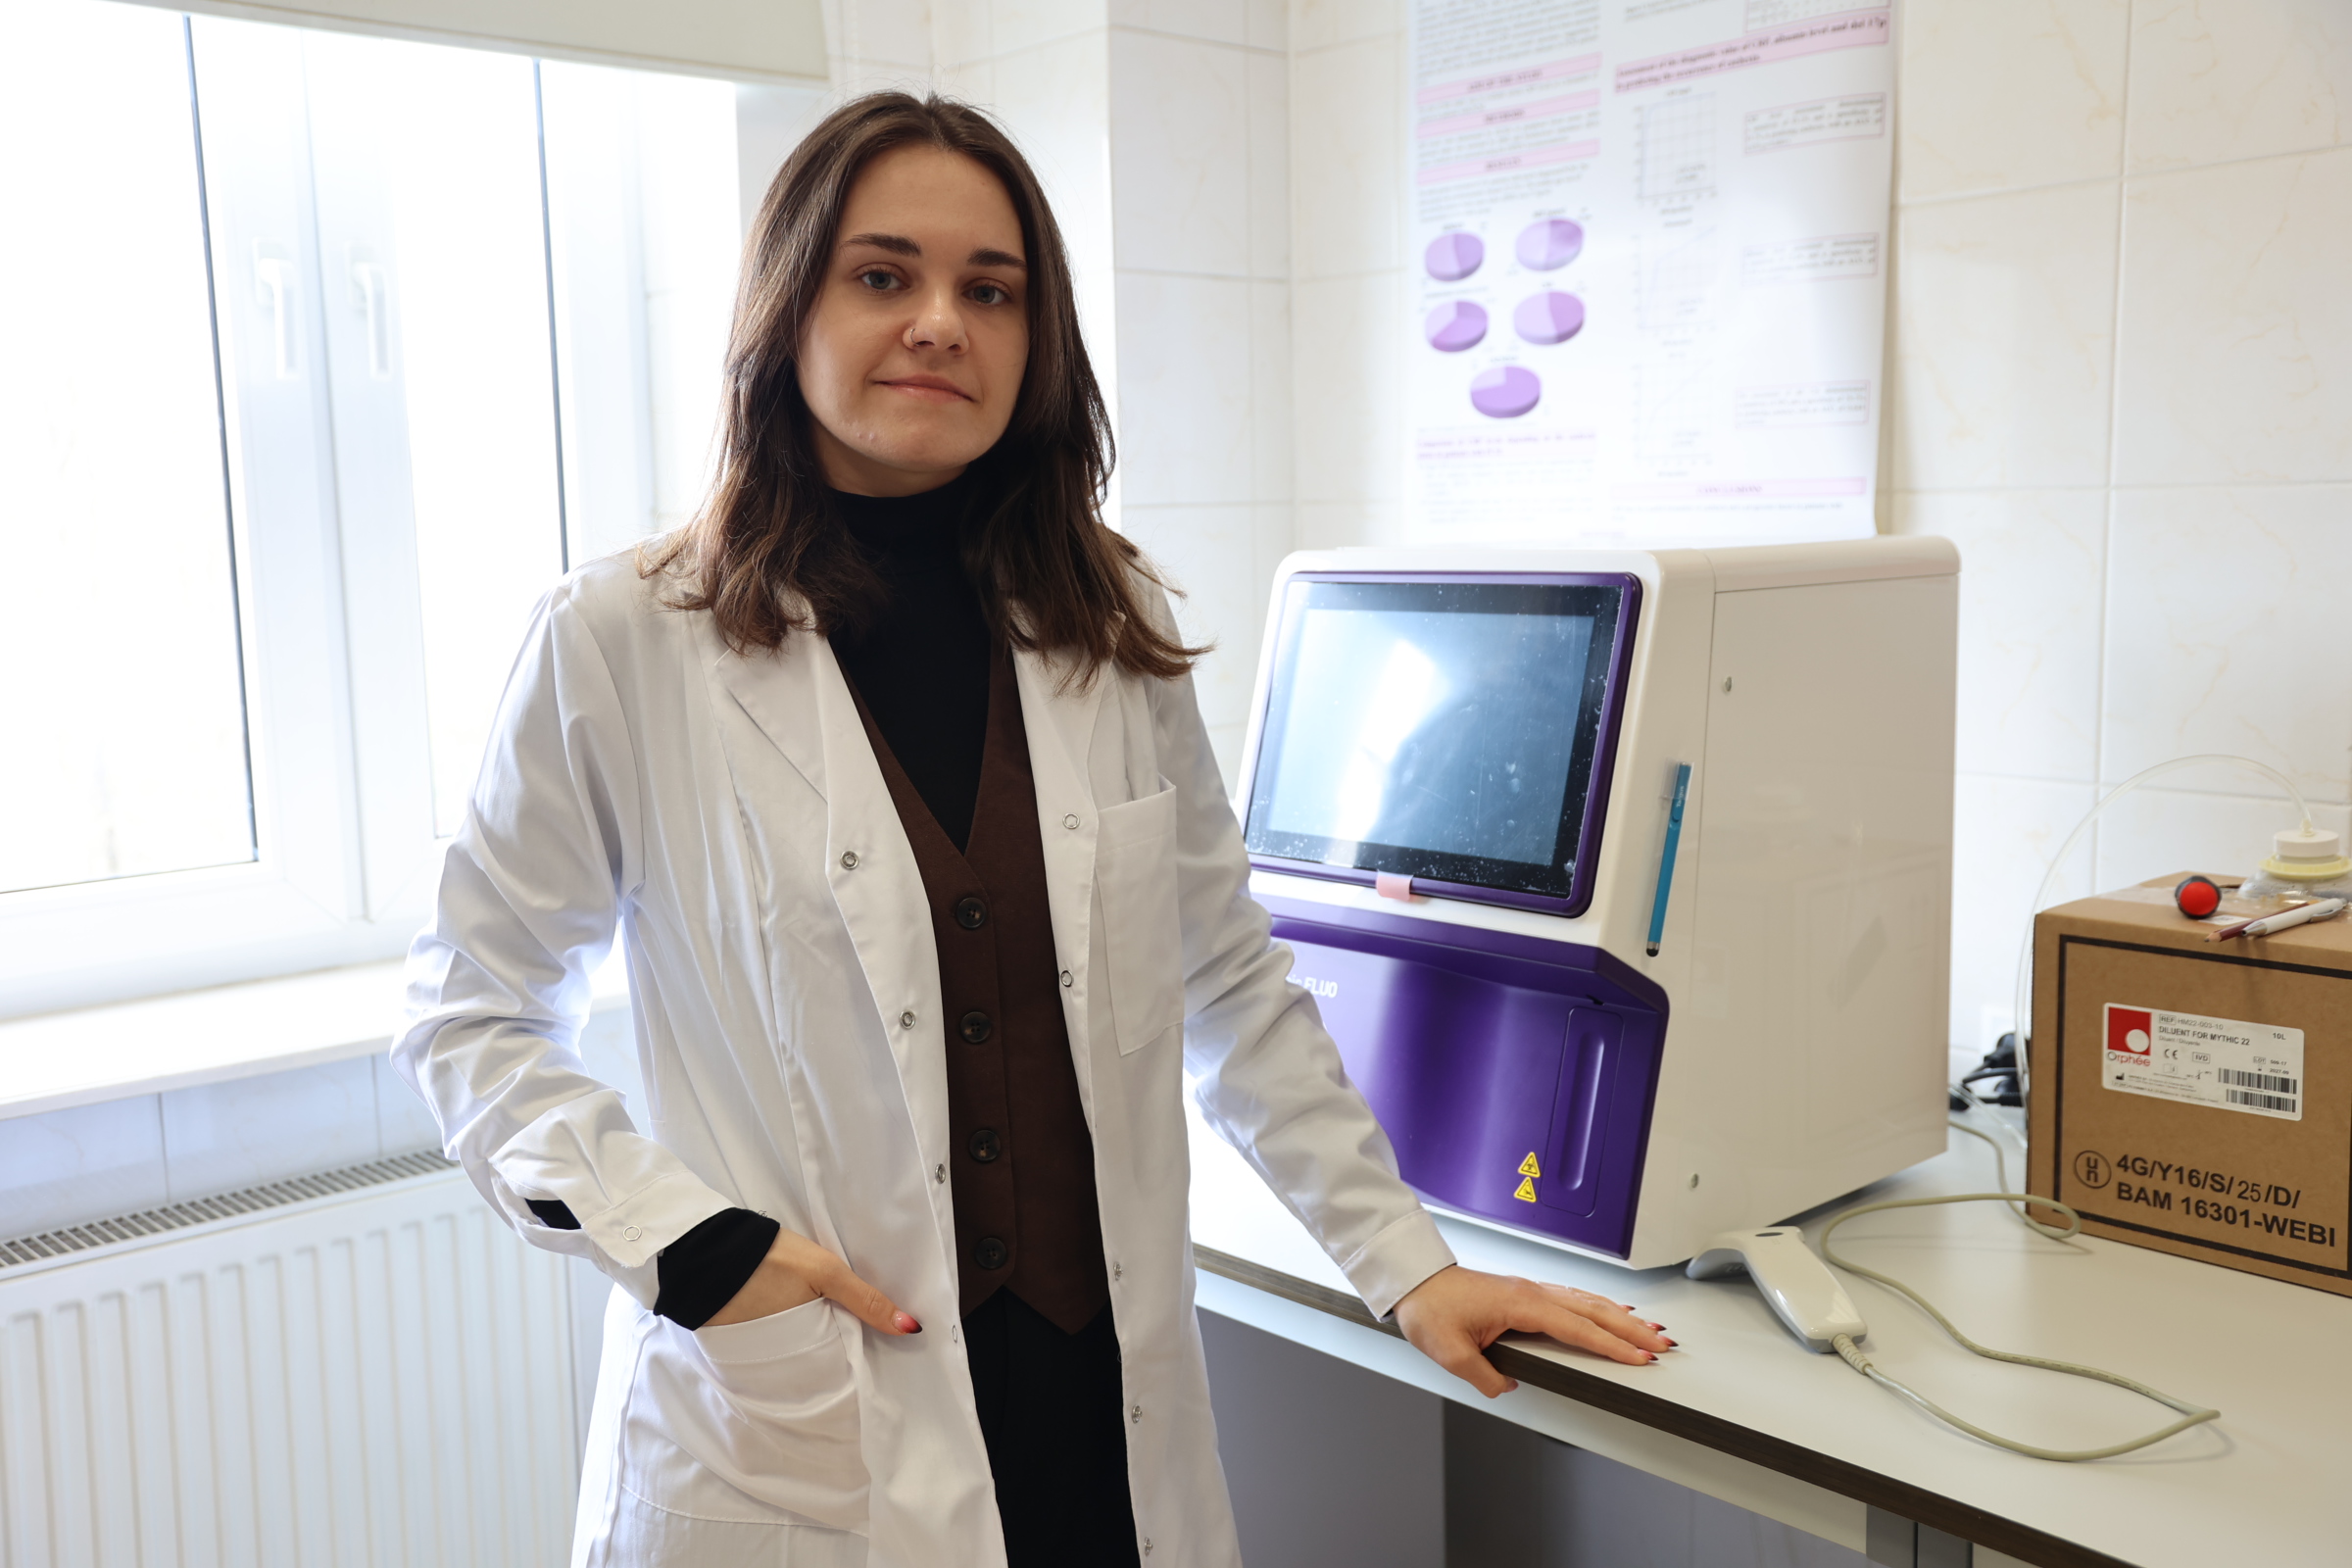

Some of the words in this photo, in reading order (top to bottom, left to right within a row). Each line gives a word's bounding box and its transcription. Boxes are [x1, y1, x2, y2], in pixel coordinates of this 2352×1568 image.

[1303, 976, 1339, 999] FLUO
[2159, 1025, 2190, 1038] DILUENT
[2192, 1031, 2209, 1041] FOR
[2210, 1033, 2240, 1045] MYTHIC
[2241, 1037, 2251, 1046] 22
[2272, 1032, 2286, 1041] 10L
[2107, 1051, 2151, 1067] Orphée
[2195, 1054, 2208, 1062] IVD
[2116, 1153, 2234, 1196] 4G/Y16/S/
[2236, 1180, 2262, 1203] 25
[2264, 1184, 2301, 1209] /D/
[2117, 1181, 2173, 1211] BAM
[2180, 1197, 2336, 1248] 16301-WEBI
